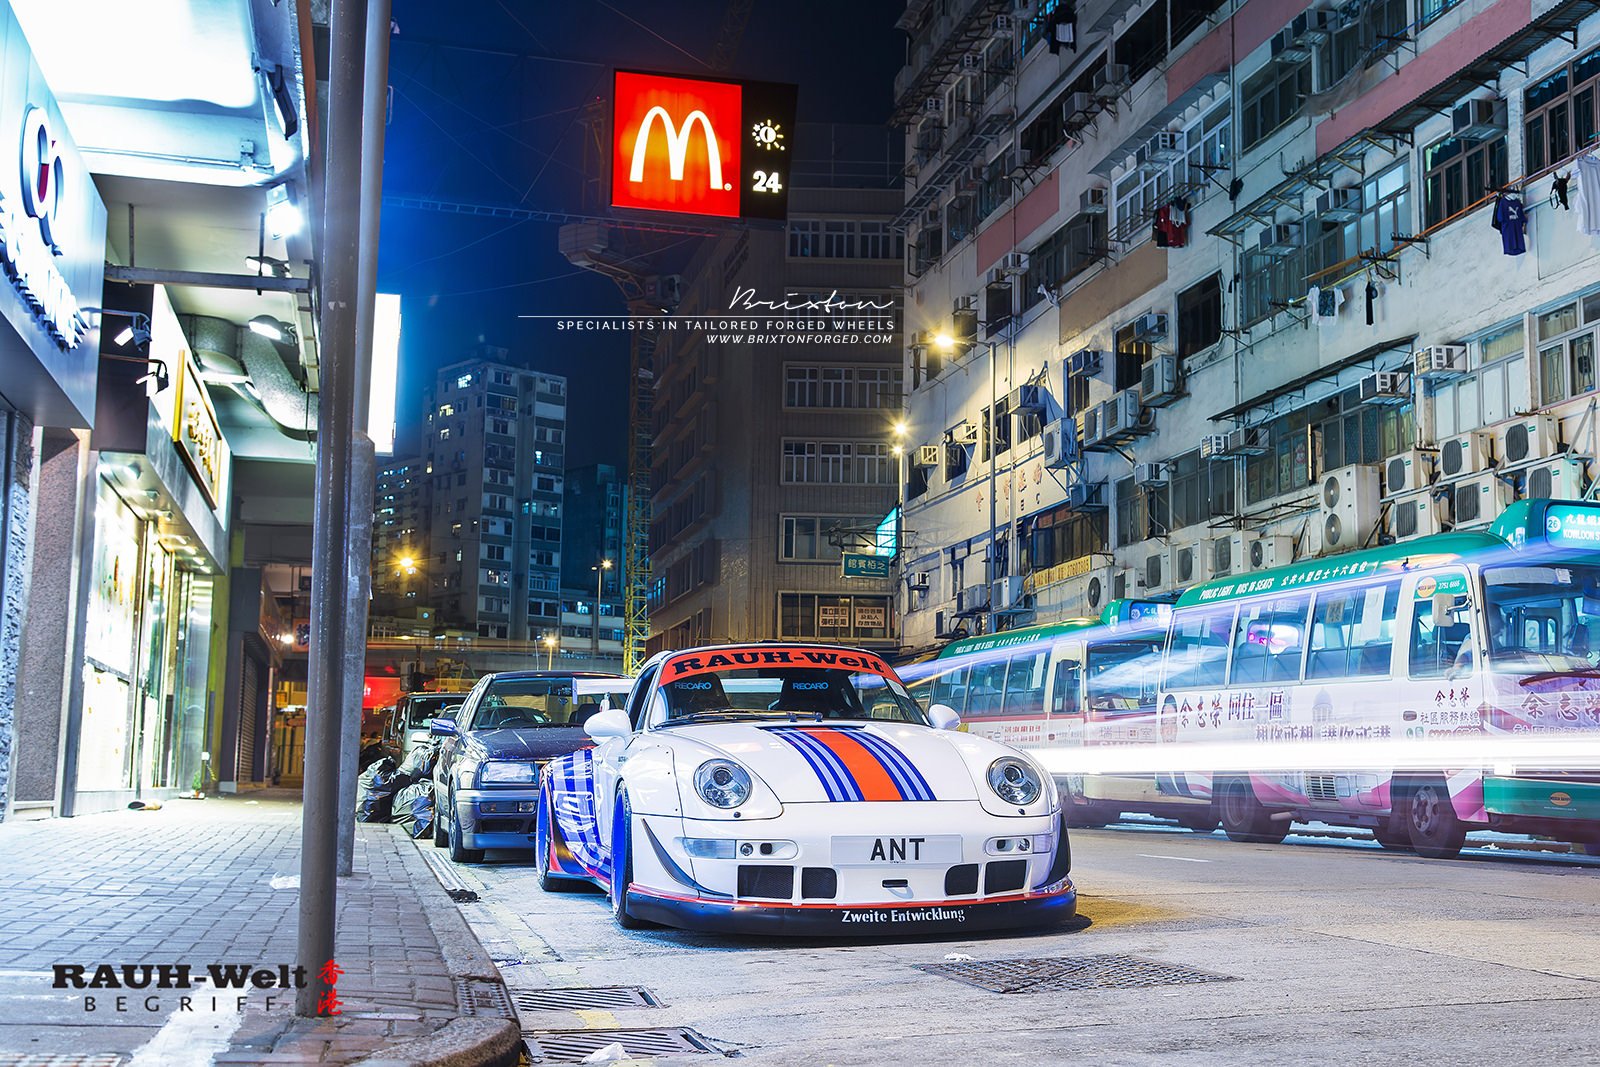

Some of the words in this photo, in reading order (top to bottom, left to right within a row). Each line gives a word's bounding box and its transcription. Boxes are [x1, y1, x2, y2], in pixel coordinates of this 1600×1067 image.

[752, 170, 783, 194] 24
[1547, 519, 1558, 529] 26
[1199, 587, 1219, 601] PUBLIC
[1217, 584, 1235, 598] LIGHT
[1235, 582, 1249, 595] BUS
[1255, 577, 1275, 592] SEATS
[672, 651, 885, 675] RAUH-Welt
[674, 681, 712, 690] RECARO
[792, 681, 829, 691] RECARO
[1228, 690, 1284, 721] 同住一區
[870, 837, 925, 861] ANT
[841, 909, 888, 923] Zweite
[891, 907, 966, 923] Entwicklung
